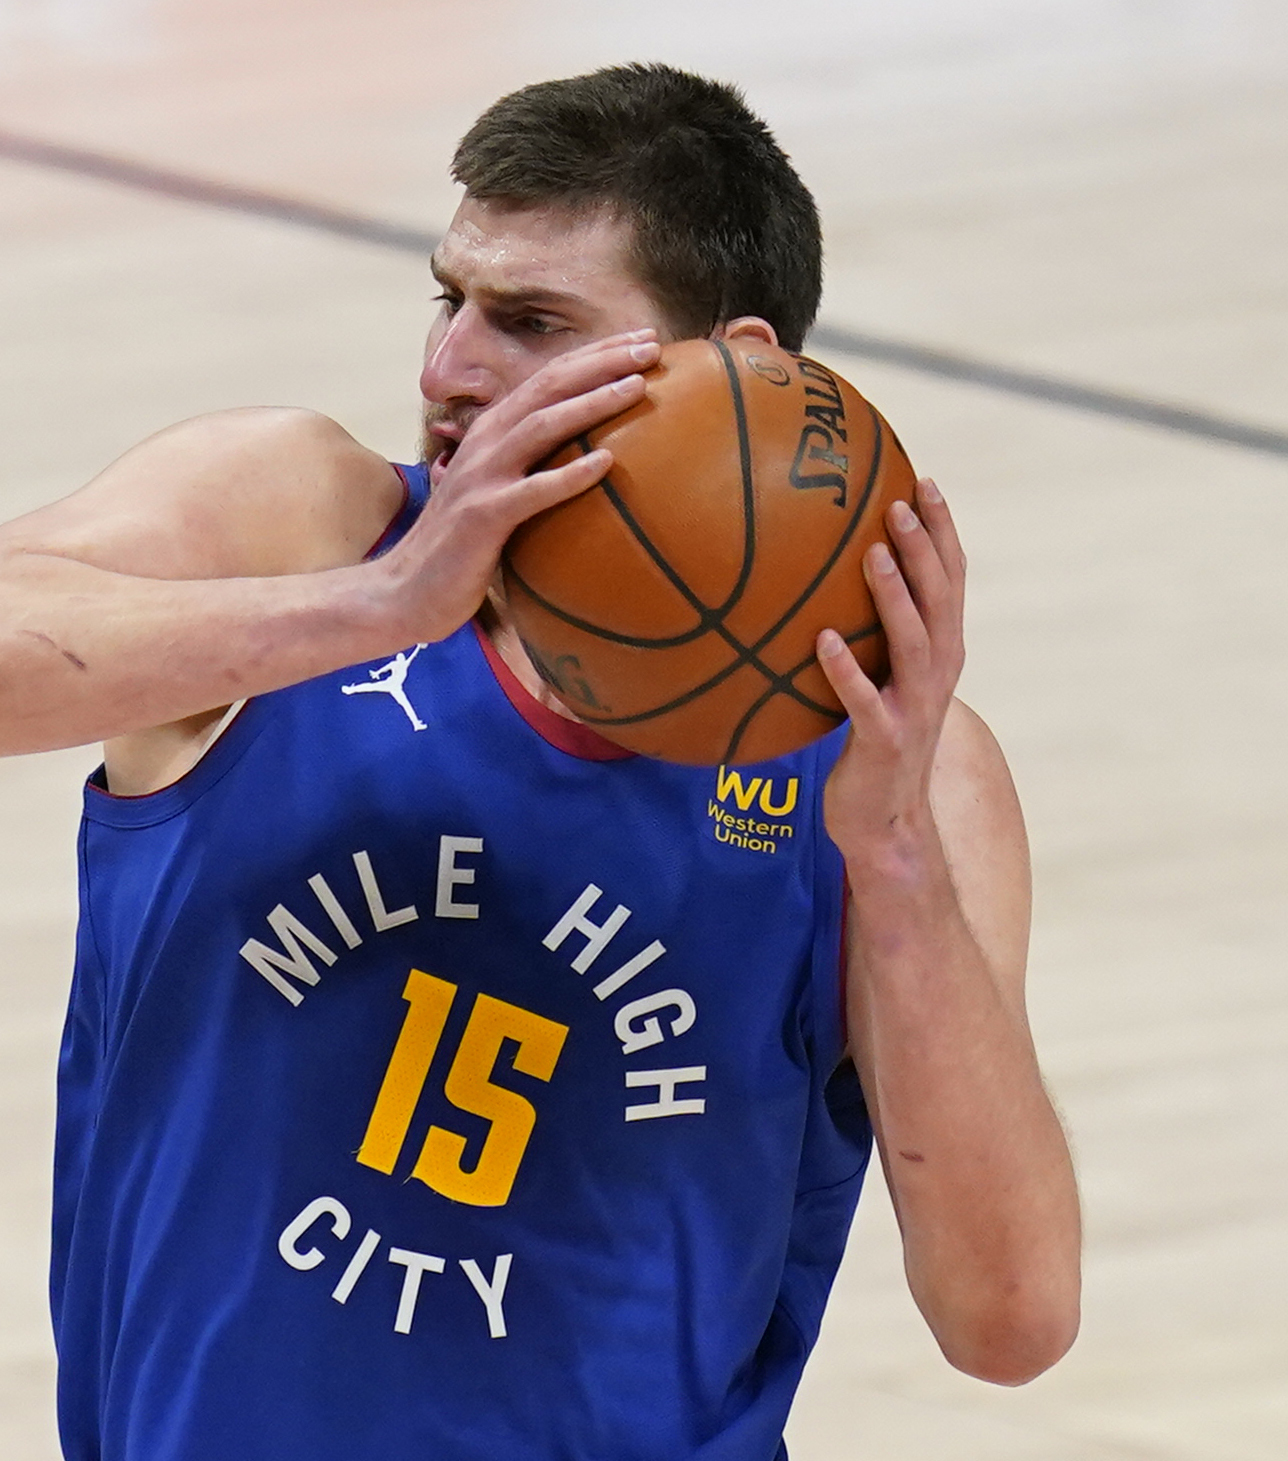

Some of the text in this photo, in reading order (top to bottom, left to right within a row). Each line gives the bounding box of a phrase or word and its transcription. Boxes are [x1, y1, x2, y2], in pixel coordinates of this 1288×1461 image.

[707, 798, 794, 838] Western
[714, 823, 777, 855] Union
[716, 764, 799, 817] WU
[238, 834, 707, 1123] MILE HIGH
[355, 967, 571, 1208] 15
[277, 1195, 514, 1339] CITY
